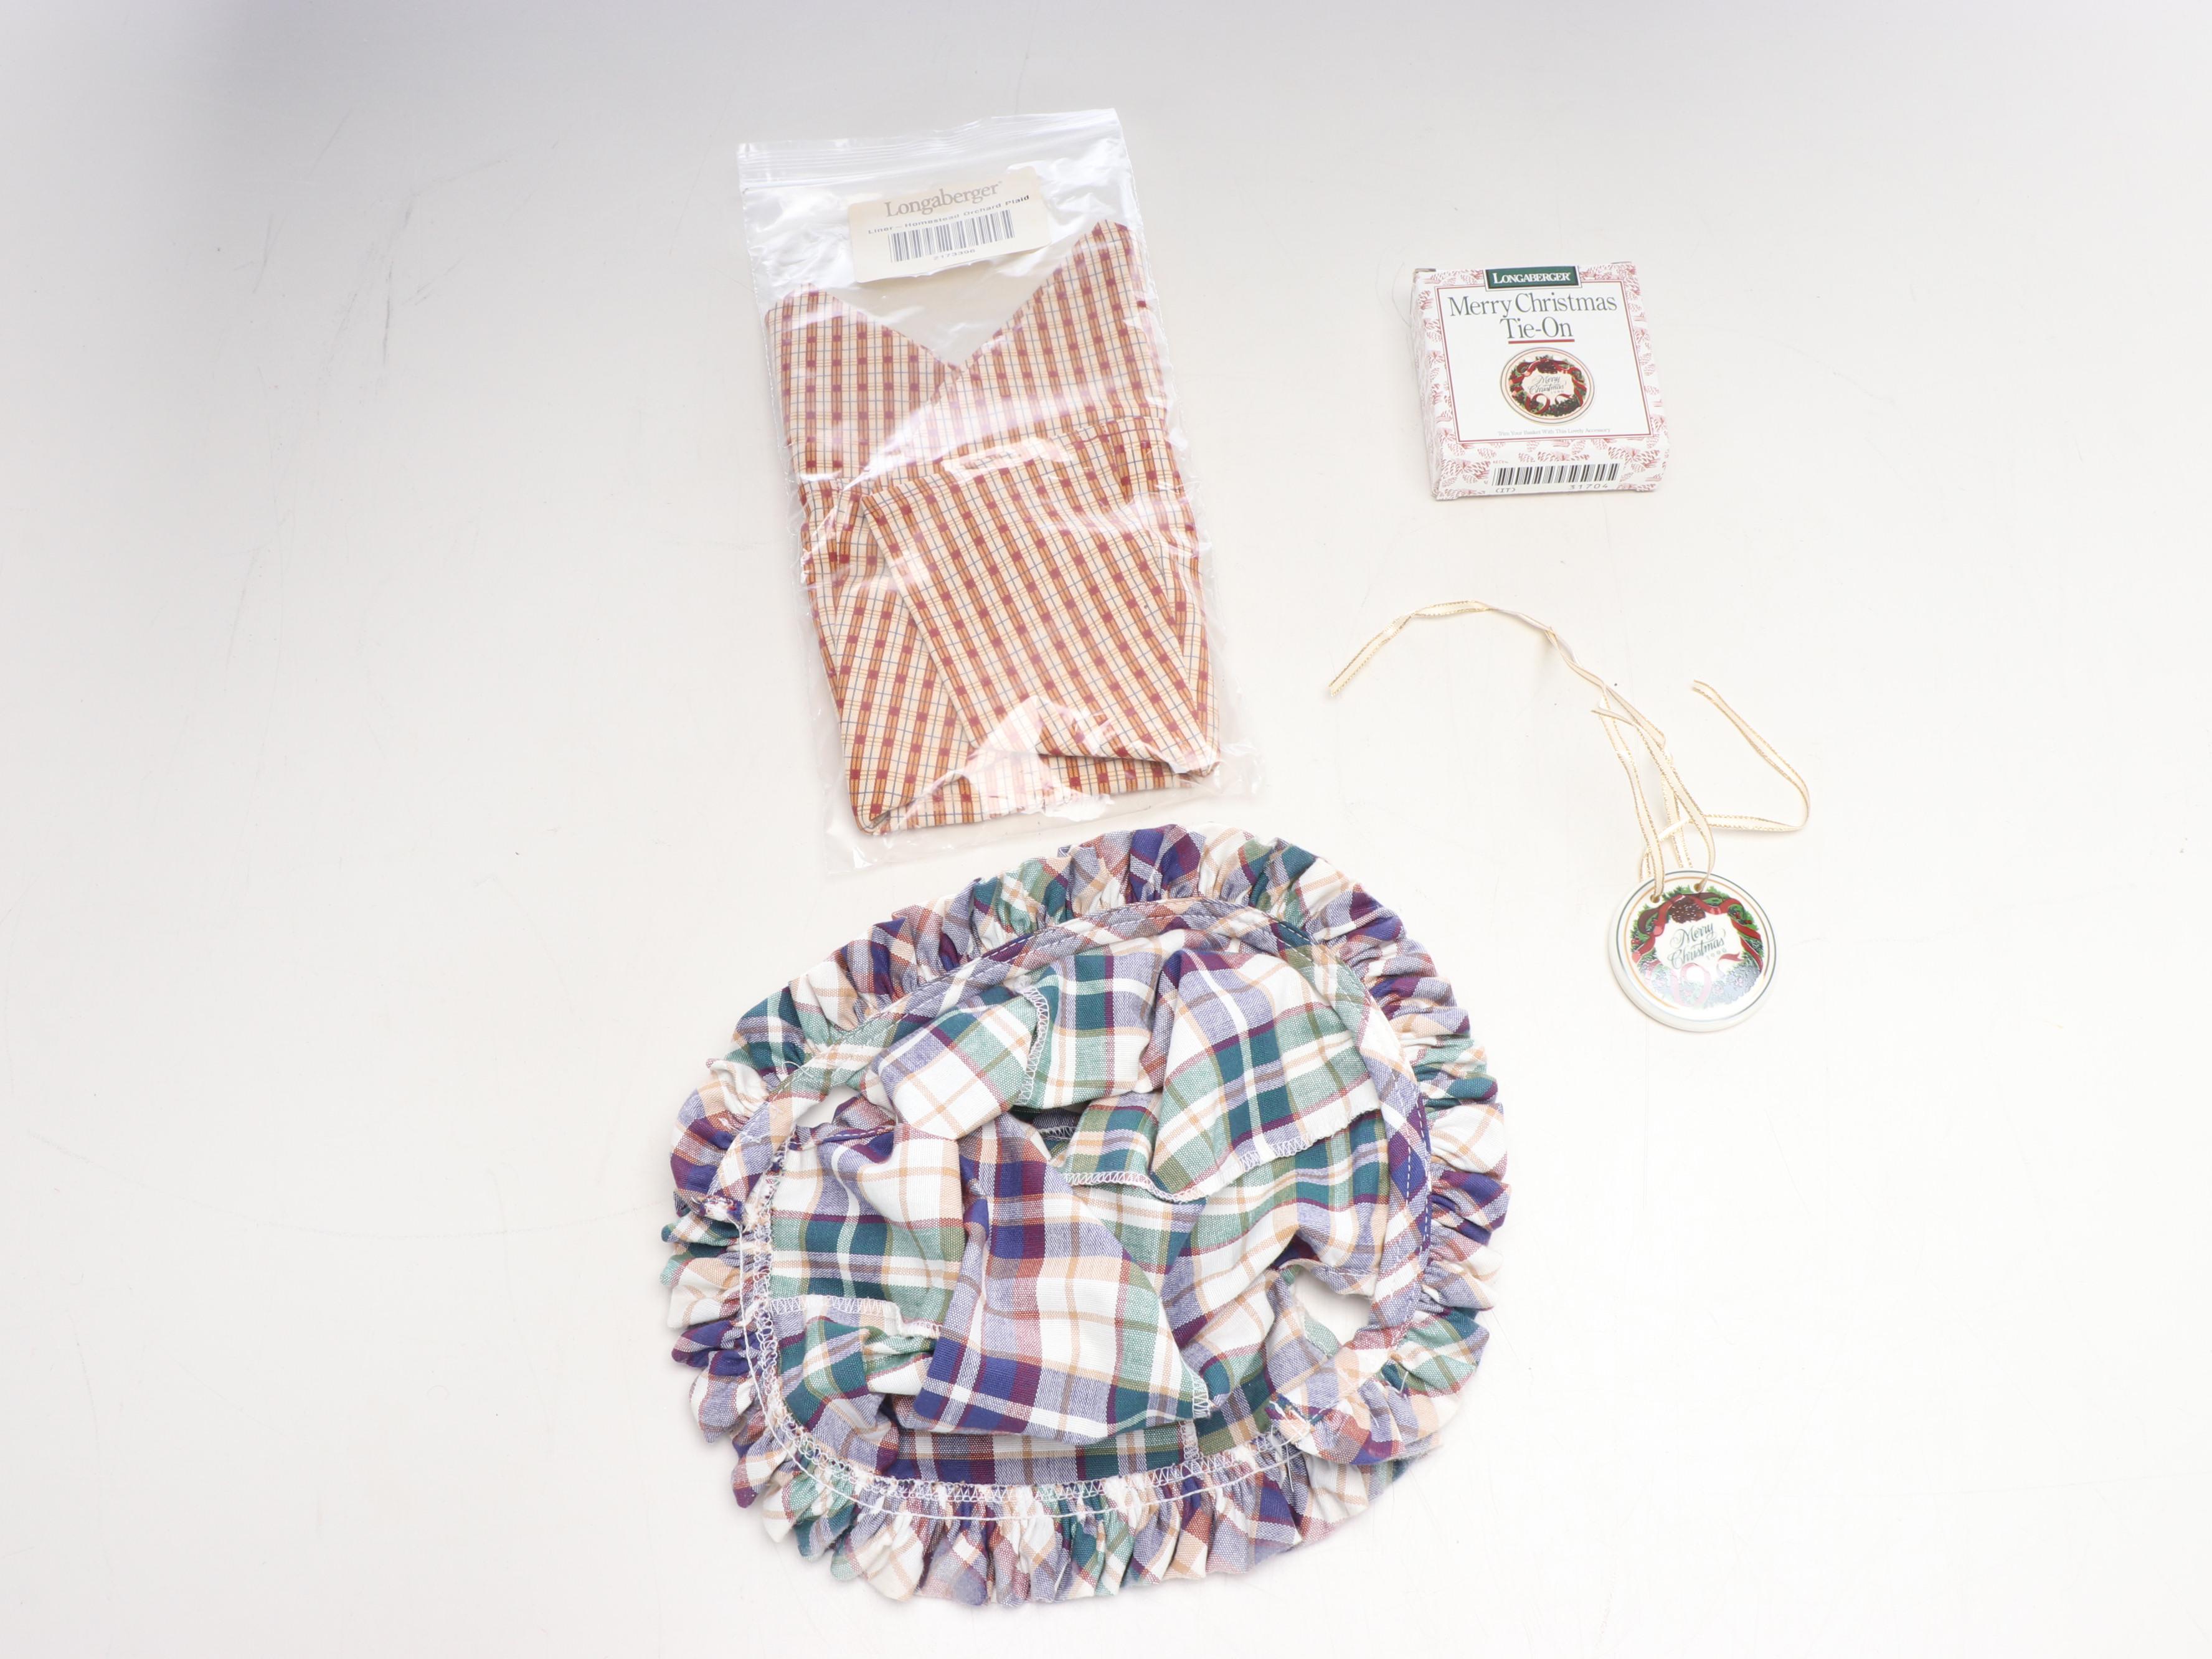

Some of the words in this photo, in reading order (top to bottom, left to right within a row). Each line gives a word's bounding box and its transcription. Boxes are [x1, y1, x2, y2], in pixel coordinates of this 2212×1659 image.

[904, 214, 960, 227] Homestead
[963, 203, 1001, 216] Orchard
[1005, 195, 1029, 206] Plaid
[1448, 295, 1513, 318] Merry
[1515, 291, 1618, 313] Christmas
[1500, 316, 1574, 339] Tie-On
[1528, 383, 1564, 394] Christmas
[1533, 375, 1561, 385] Merry
[1670, 923, 1713, 948] Merry
[1667, 936, 1724, 970] Christmas
